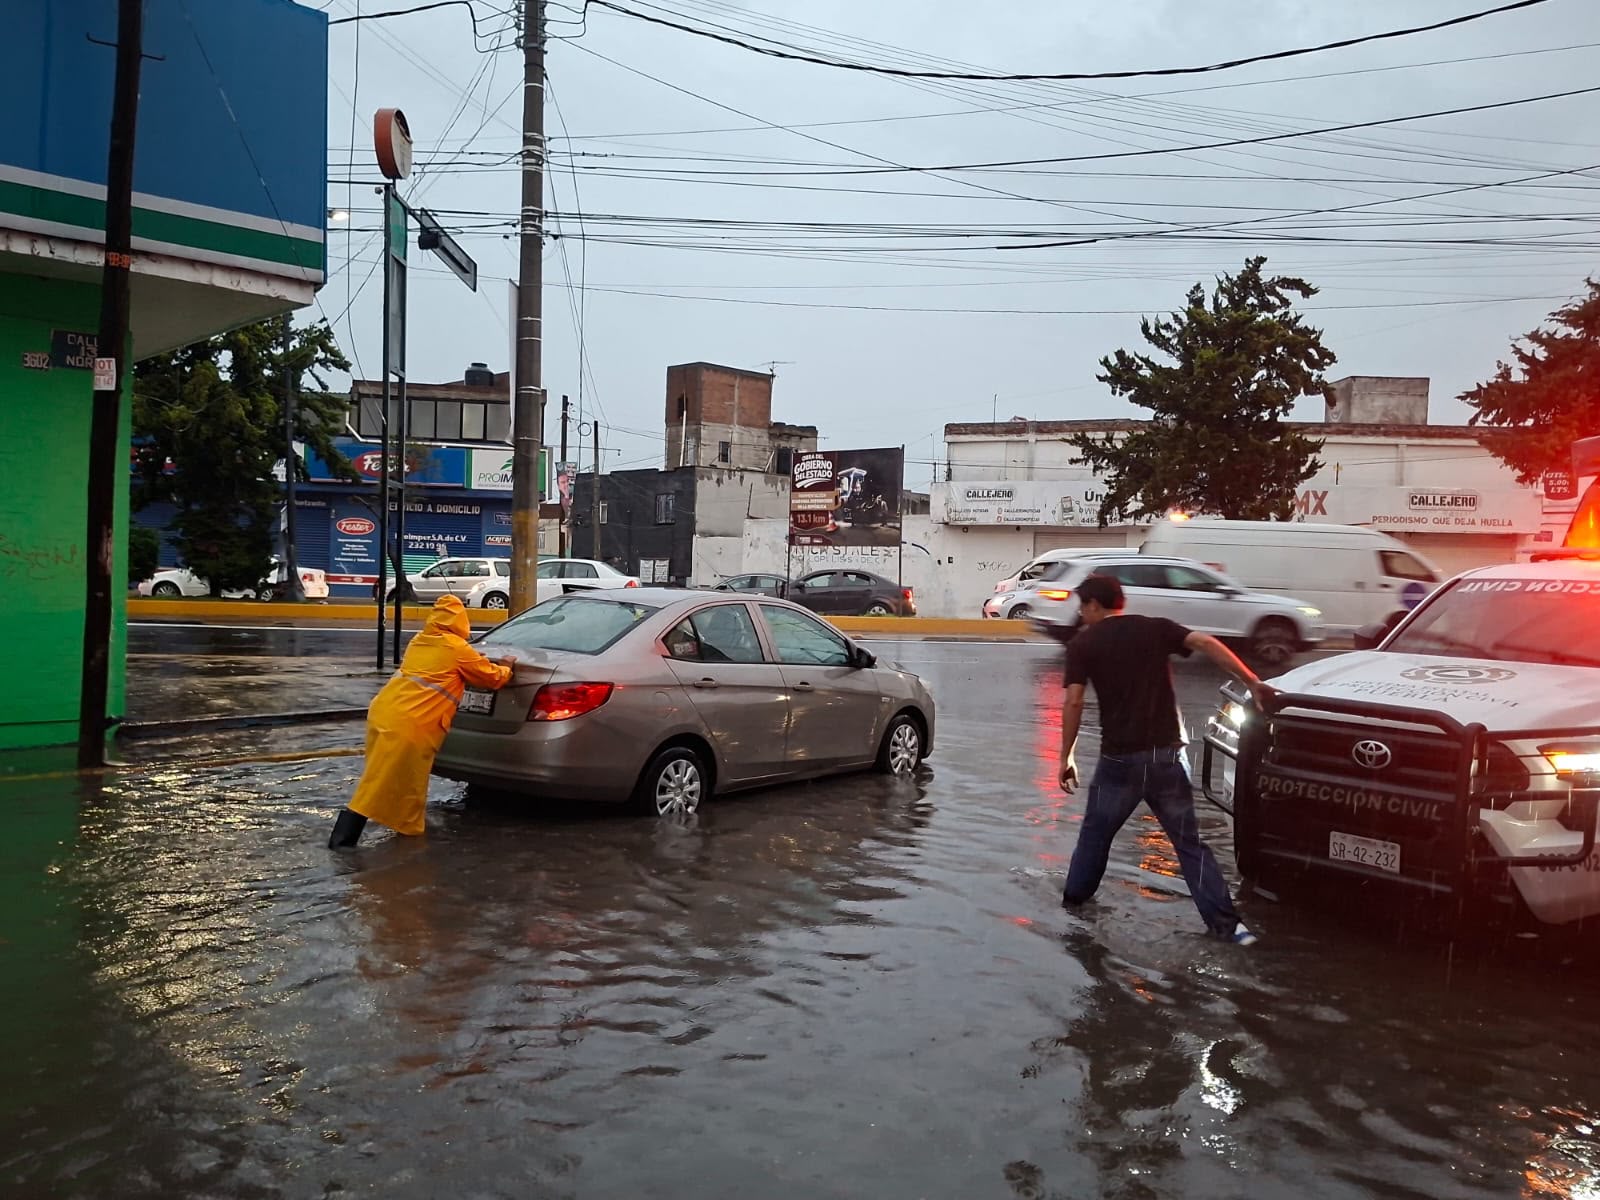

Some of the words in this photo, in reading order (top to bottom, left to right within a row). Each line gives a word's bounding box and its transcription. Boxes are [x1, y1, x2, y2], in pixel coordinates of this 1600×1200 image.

[67, 334, 98, 347] CALL
[81, 346, 98, 358] 13
[66, 356, 94, 368] NOR
[794, 460, 832, 475] GOBIERNO
[479, 472, 513, 484] PROIM
[805, 470, 832, 479] ESTADO
[966, 490, 1013, 498] CALLEJERO
[1084, 488, 1103, 502] Ún
[1411, 495, 1476, 507] CALLEJERO
[426, 504, 433, 512] A
[436, 504, 480, 514] DOMICILIO
[797, 513, 811, 523] 13.1
[813, 514, 826, 523] km
[1372, 516, 1428, 525] PERIODISMO
[1432, 517, 1450, 525] QUE
[1454, 518, 1476, 526] DEJA
[1480, 519, 1513, 527] HUELLA
[1257, 775, 1383, 811] PROTECCIÓN
[1387, 799, 1442, 821] CIVIL
[1332, 841, 1397, 869] SR-42-232
